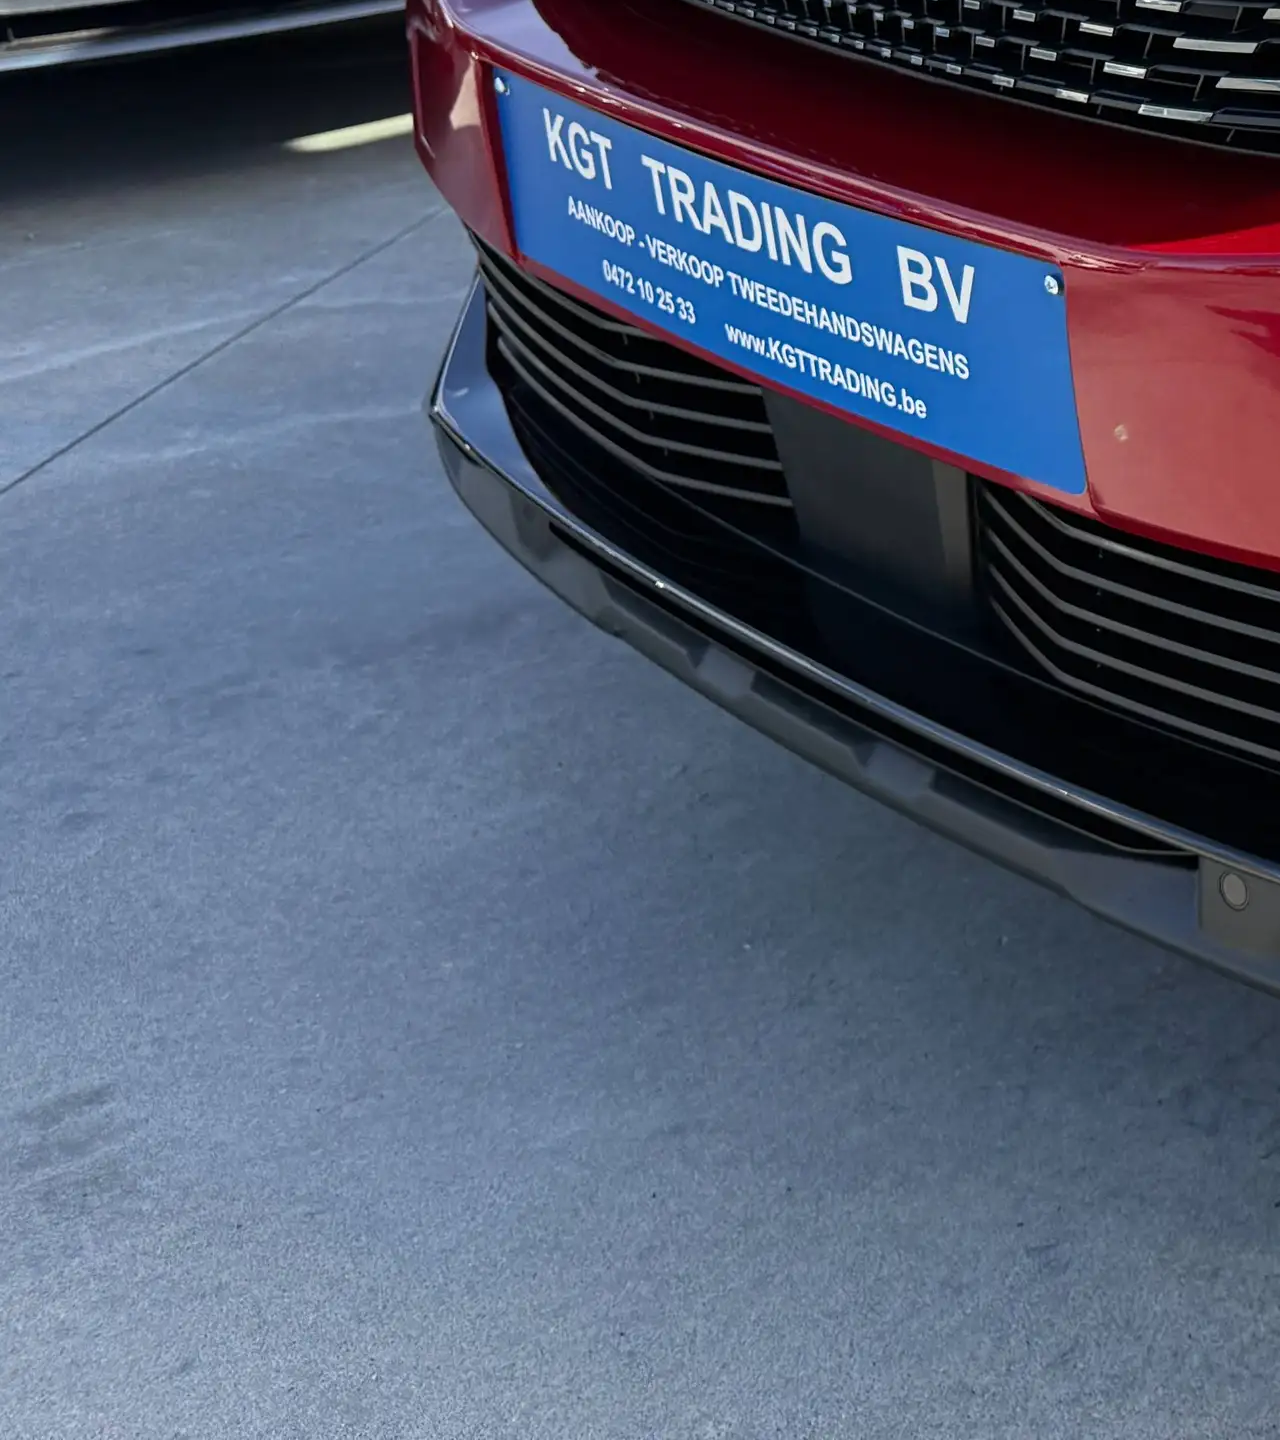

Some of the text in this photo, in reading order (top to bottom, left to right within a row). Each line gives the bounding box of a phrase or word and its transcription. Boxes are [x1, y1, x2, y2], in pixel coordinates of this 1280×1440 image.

[543, 108, 975, 324] KGT TRADING BV
[568, 195, 636, 247] AANKOOP
[645, 233, 725, 288] VERKOOP
[726, 271, 970, 380] TWEEDEHANDSWAGENS
[602, 259, 696, 325] 0472 10 25 33
[724, 323, 928, 419] www.KGTTRADING.be
